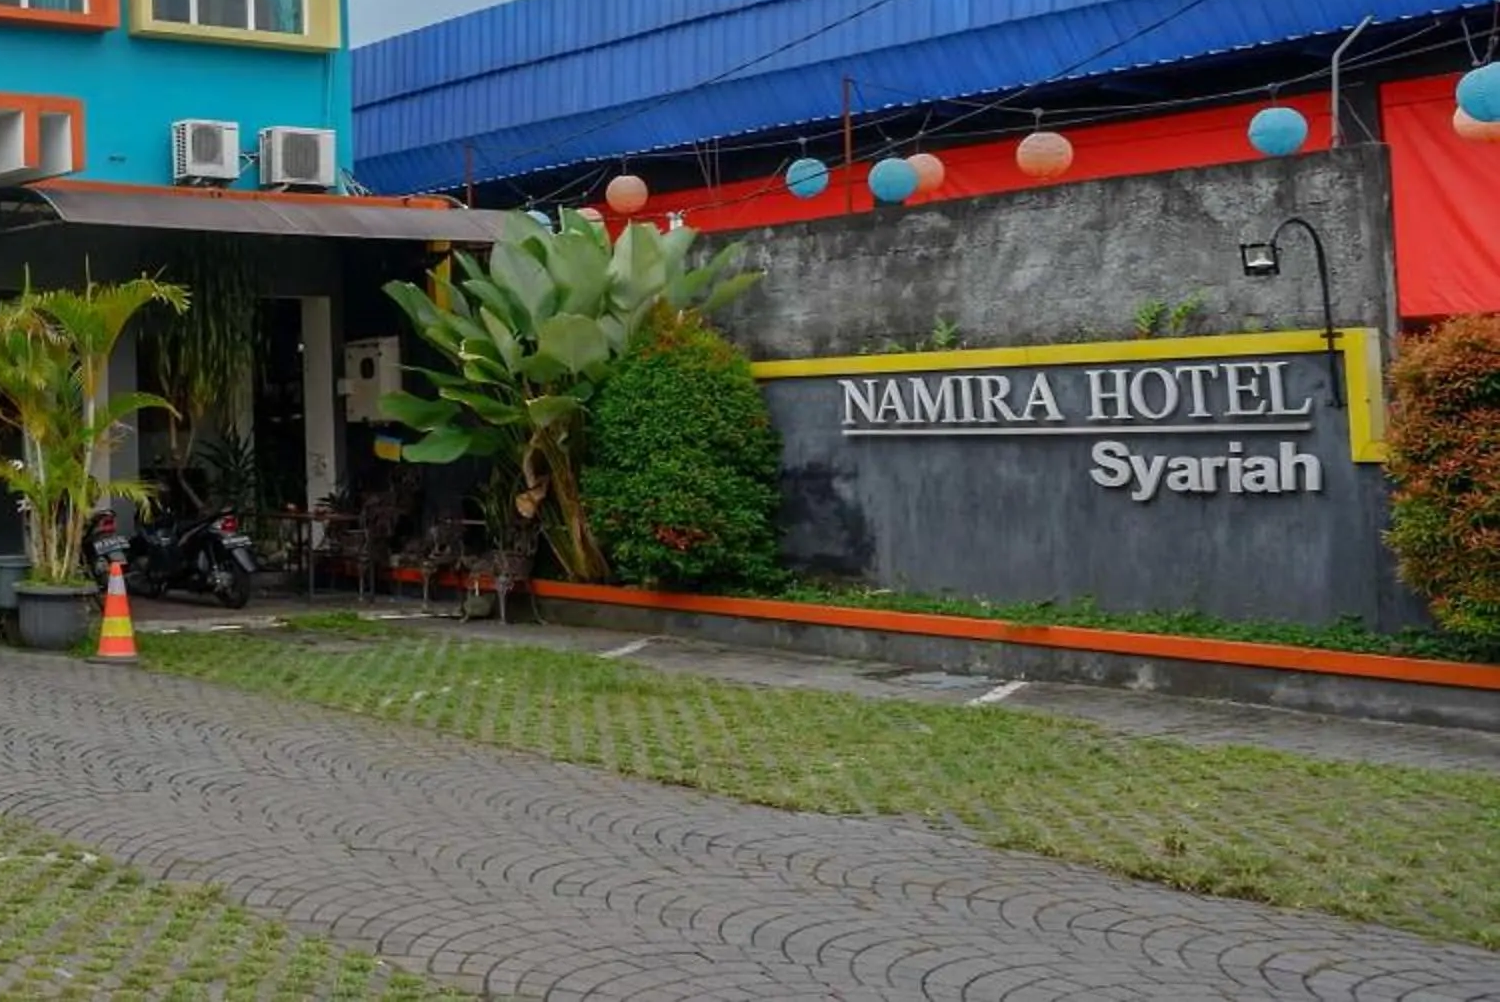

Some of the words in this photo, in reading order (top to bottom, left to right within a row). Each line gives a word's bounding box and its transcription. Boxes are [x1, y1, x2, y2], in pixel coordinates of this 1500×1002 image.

[838, 372, 1064, 426] NAMIRA
[1086, 360, 1313, 421] HOTEL
[1089, 441, 1322, 502] Syariah
